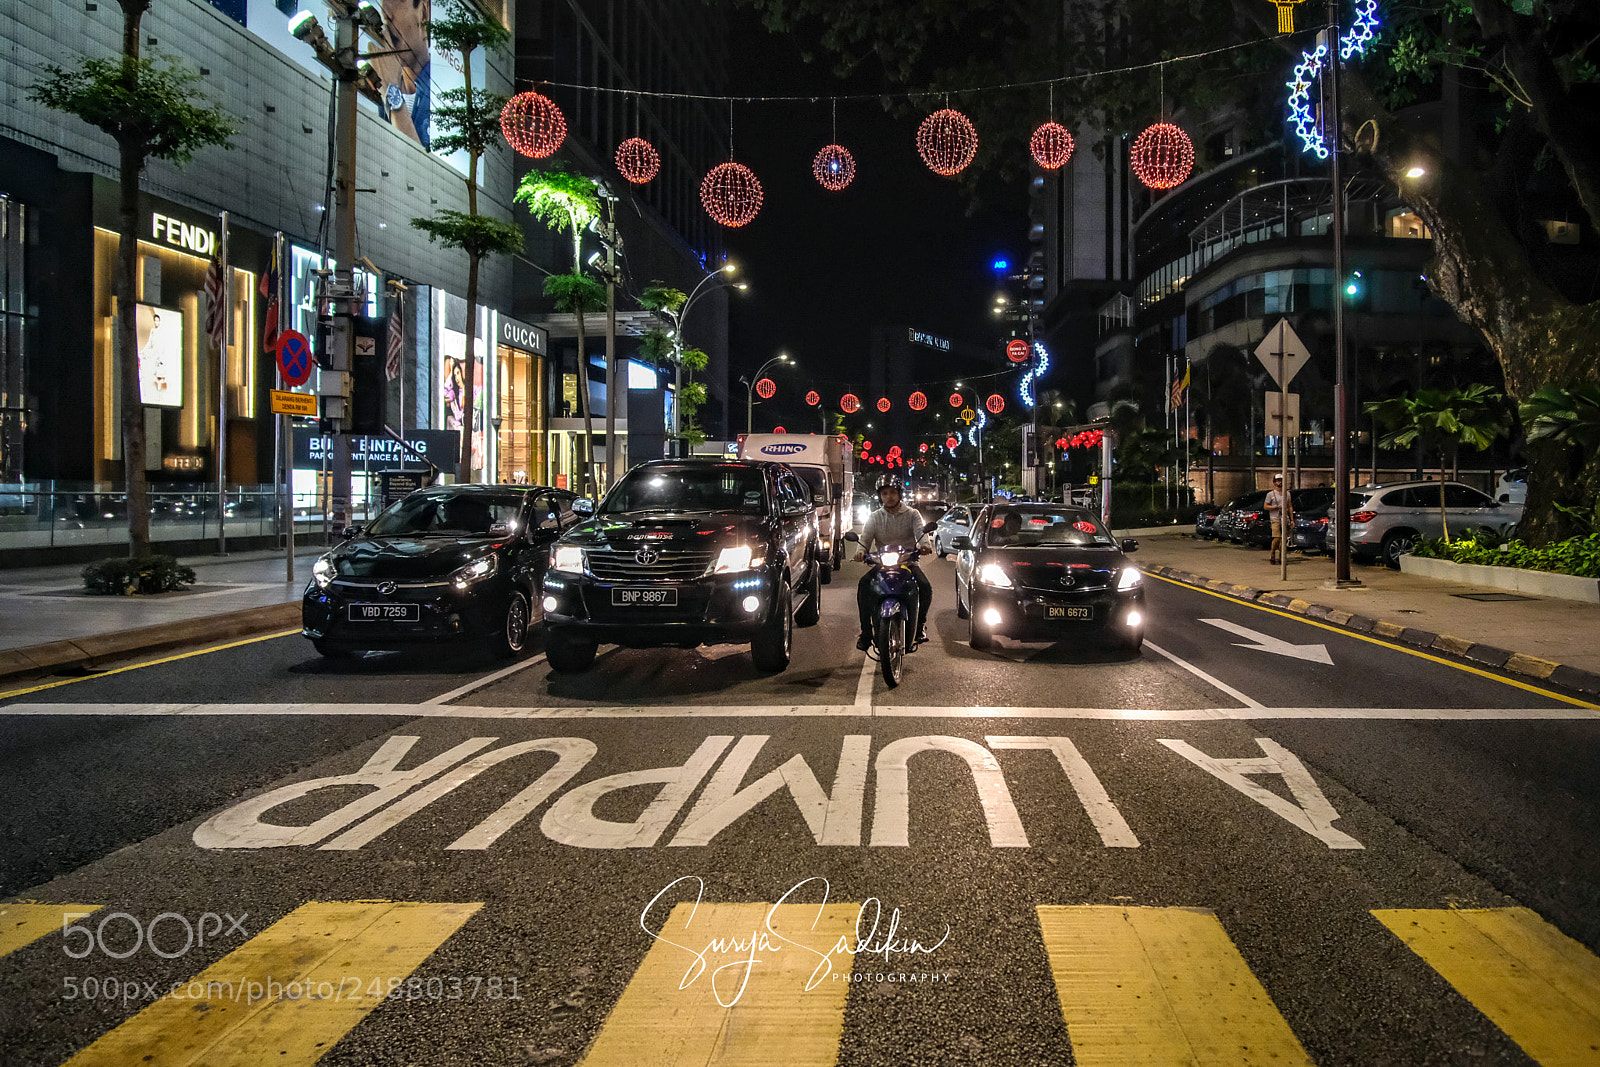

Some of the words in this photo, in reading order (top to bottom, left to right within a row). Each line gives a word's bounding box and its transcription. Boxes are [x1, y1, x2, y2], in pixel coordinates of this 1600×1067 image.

[152, 212, 216, 255] FENDI
[504, 322, 539, 349] GUCCI
[765, 445, 804, 453] RHINO
[622, 591, 641, 602] BNP
[643, 591, 668, 602] 9867
[362, 606, 381, 617] VBD
[383, 606, 407, 617] 7259
[1049, 608, 1065, 617] BKN
[1067, 608, 1088, 617] 6673
[193, 734, 1142, 850] LUMPUR
